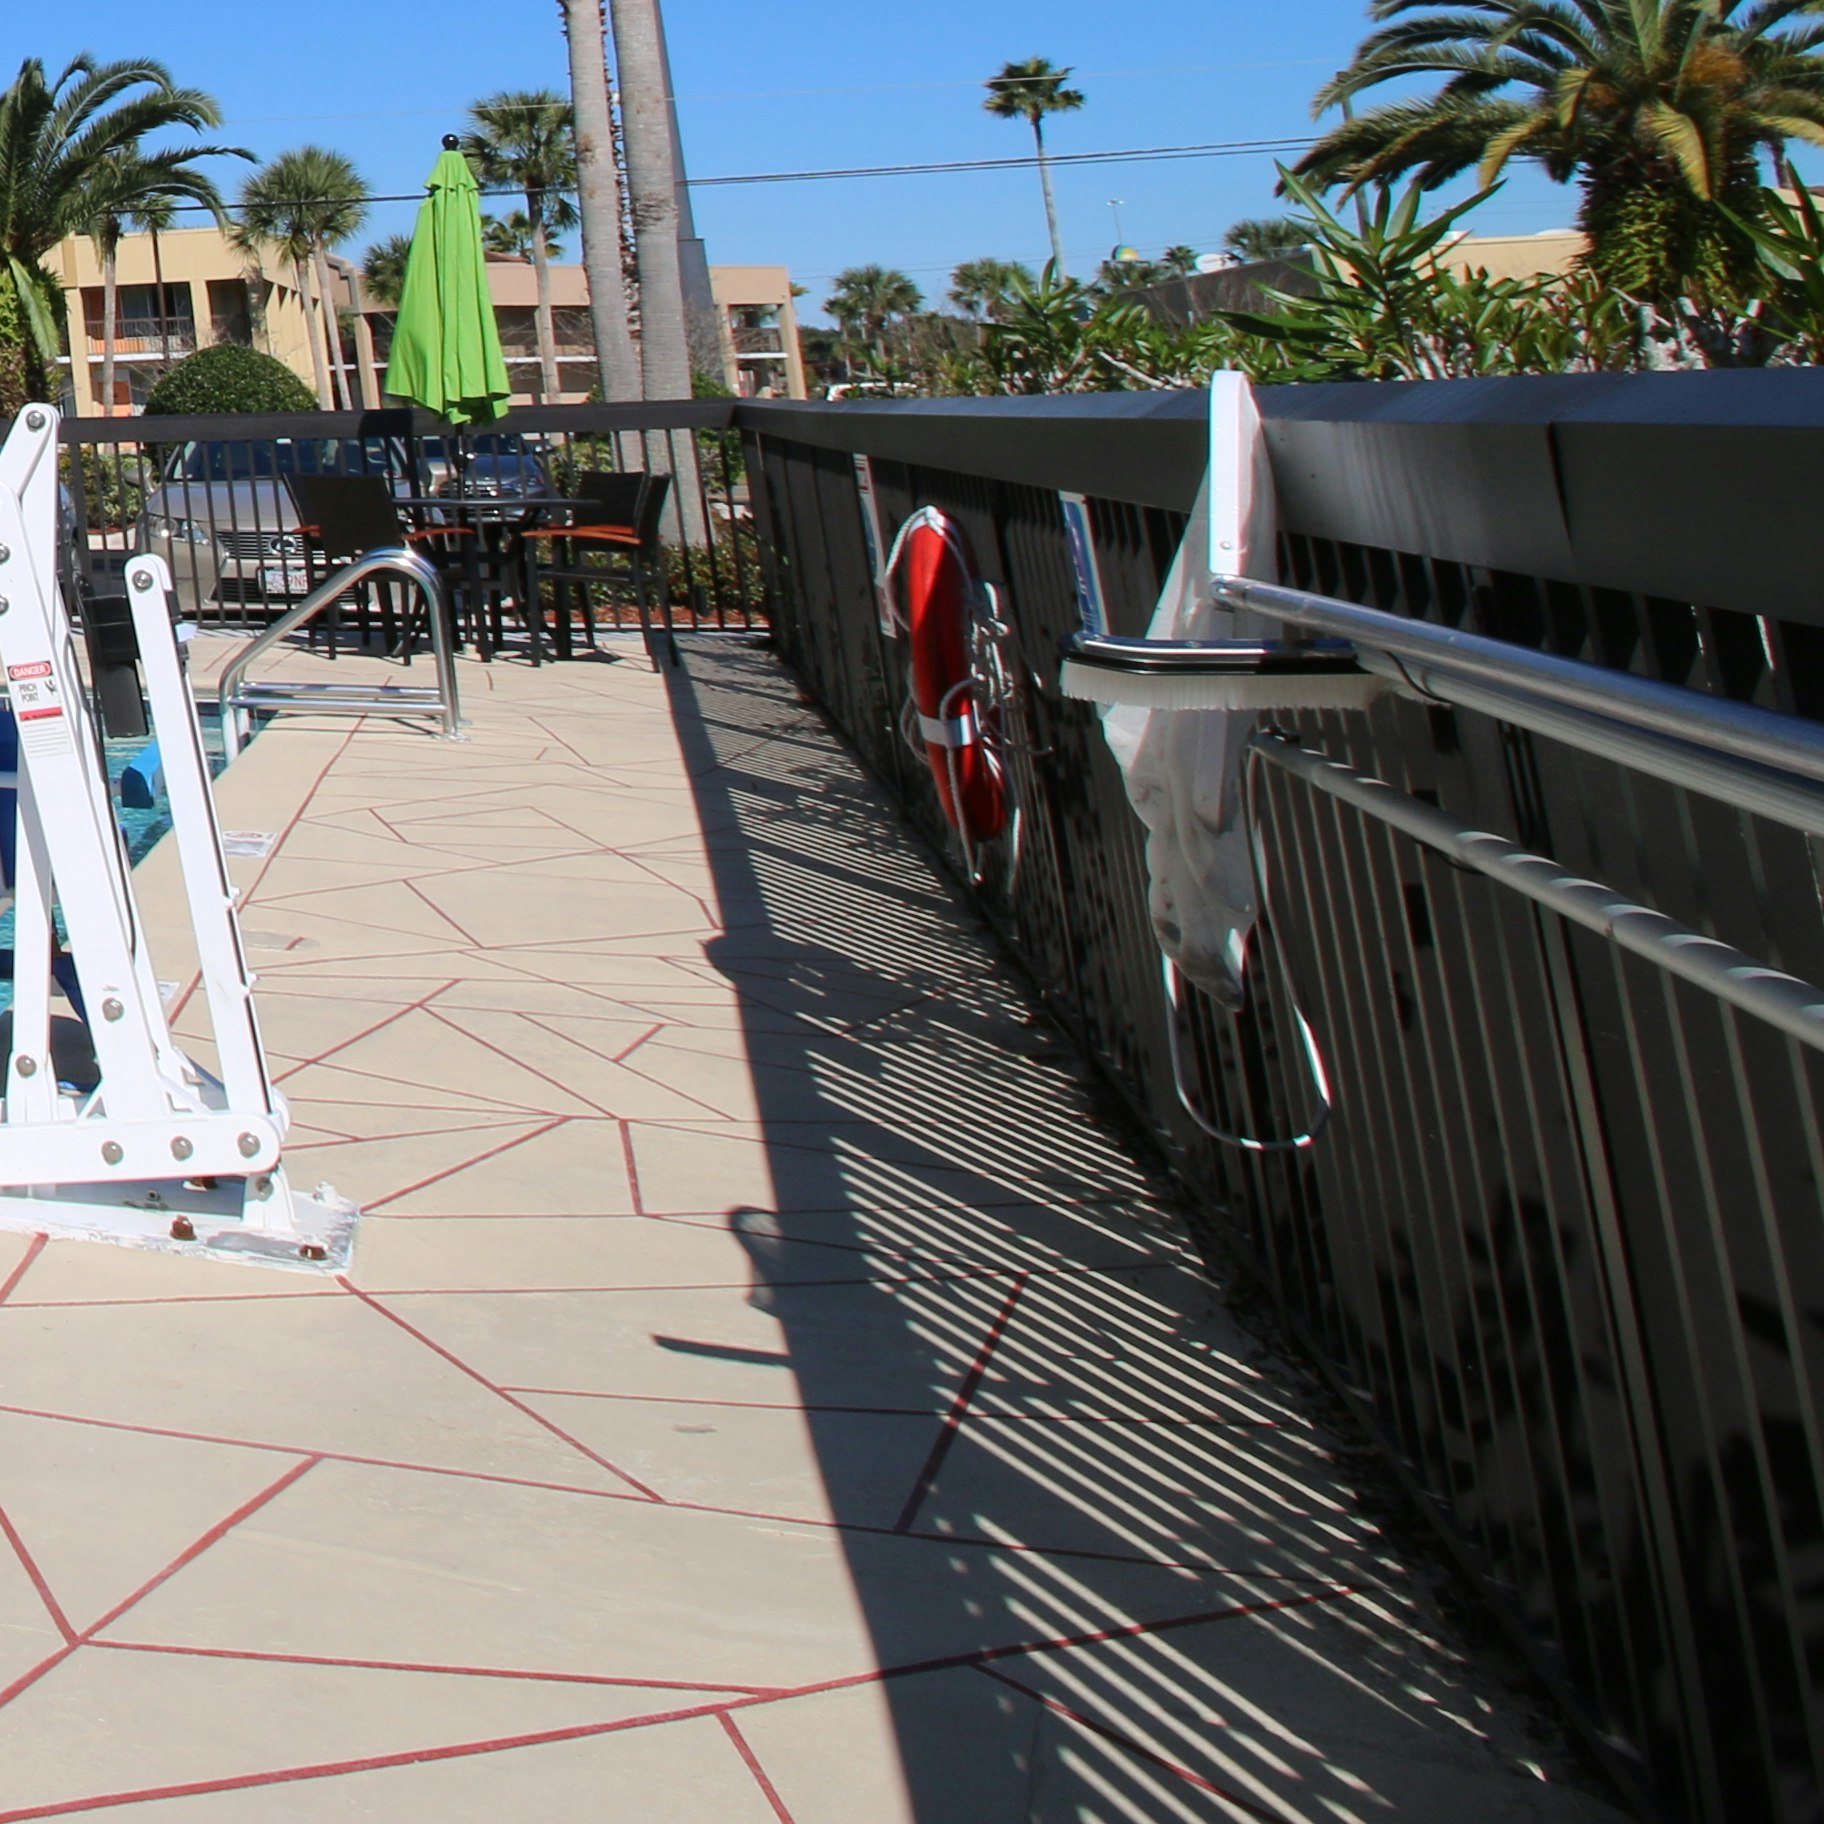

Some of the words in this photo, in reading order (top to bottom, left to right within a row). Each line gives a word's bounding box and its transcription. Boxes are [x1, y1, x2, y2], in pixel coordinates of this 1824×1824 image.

[13, 664, 46, 677] DANGER
[18, 683, 38, 692] PINCH
[21, 692, 40, 704] POINT
